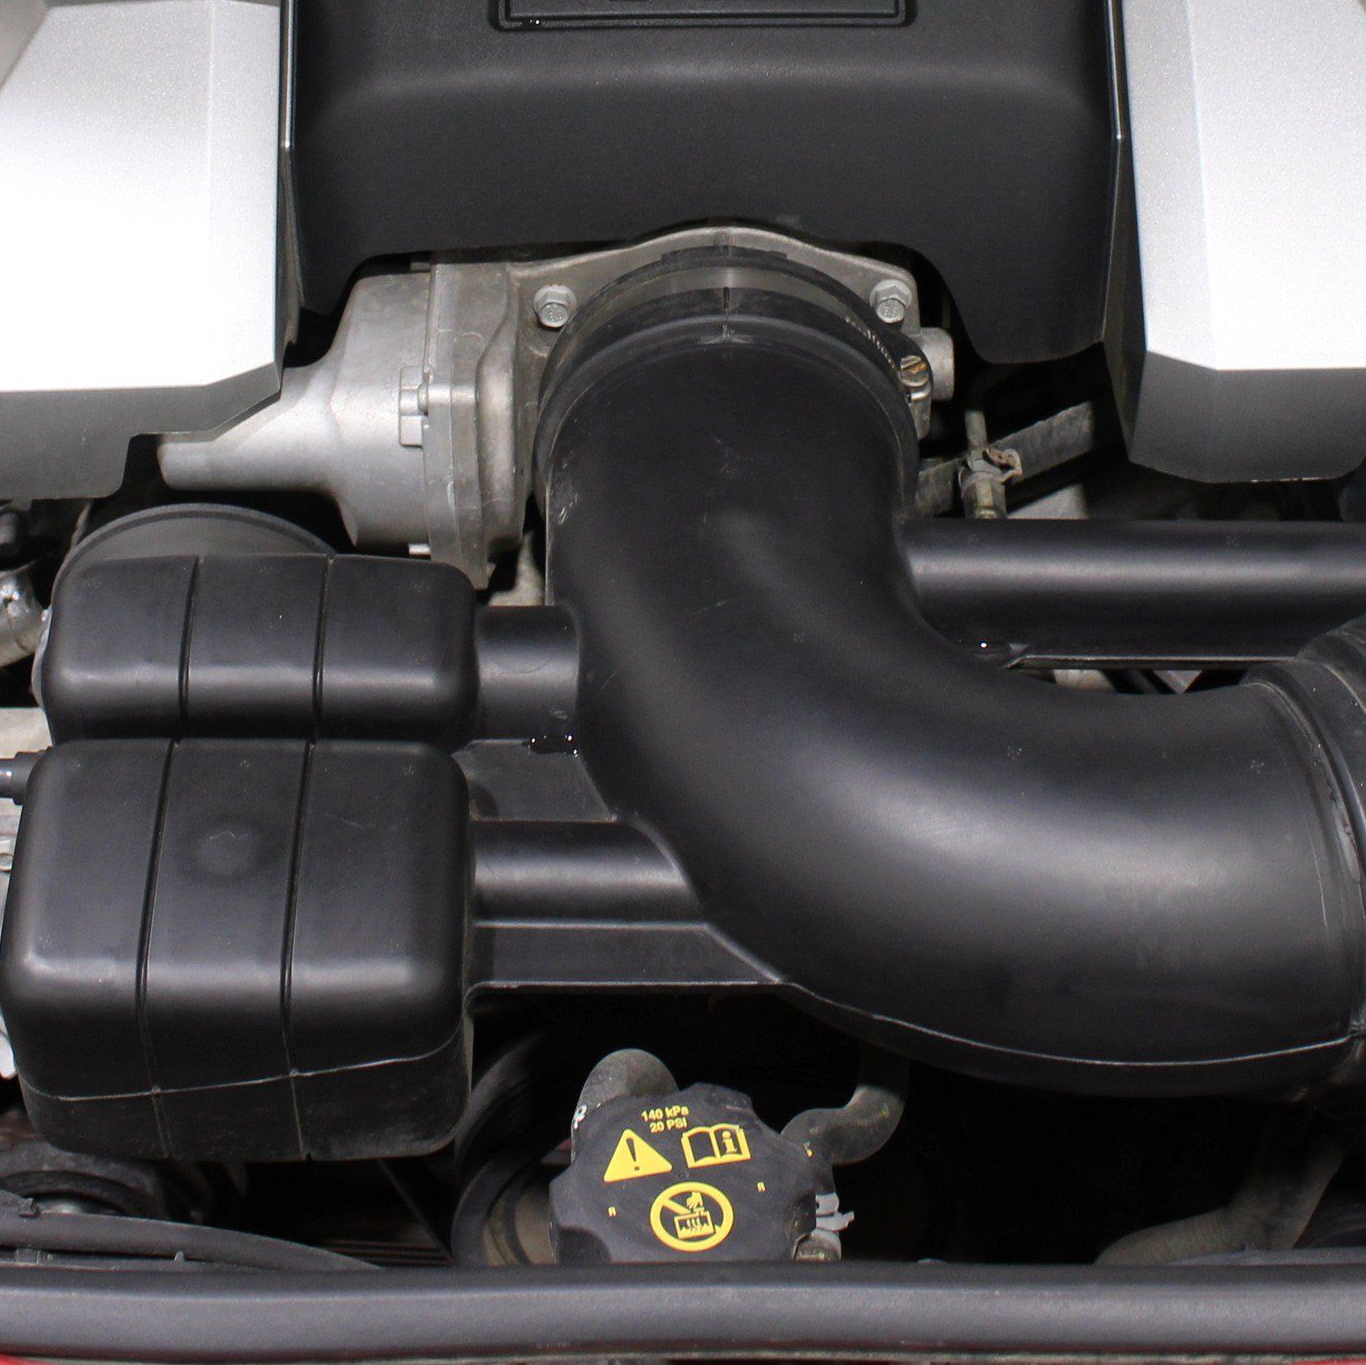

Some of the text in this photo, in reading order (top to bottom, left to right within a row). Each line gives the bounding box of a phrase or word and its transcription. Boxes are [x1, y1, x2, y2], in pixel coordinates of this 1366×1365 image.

[641, 1105, 690, 1122] 140 kPa
[649, 1117, 688, 1133] 20 PSI
